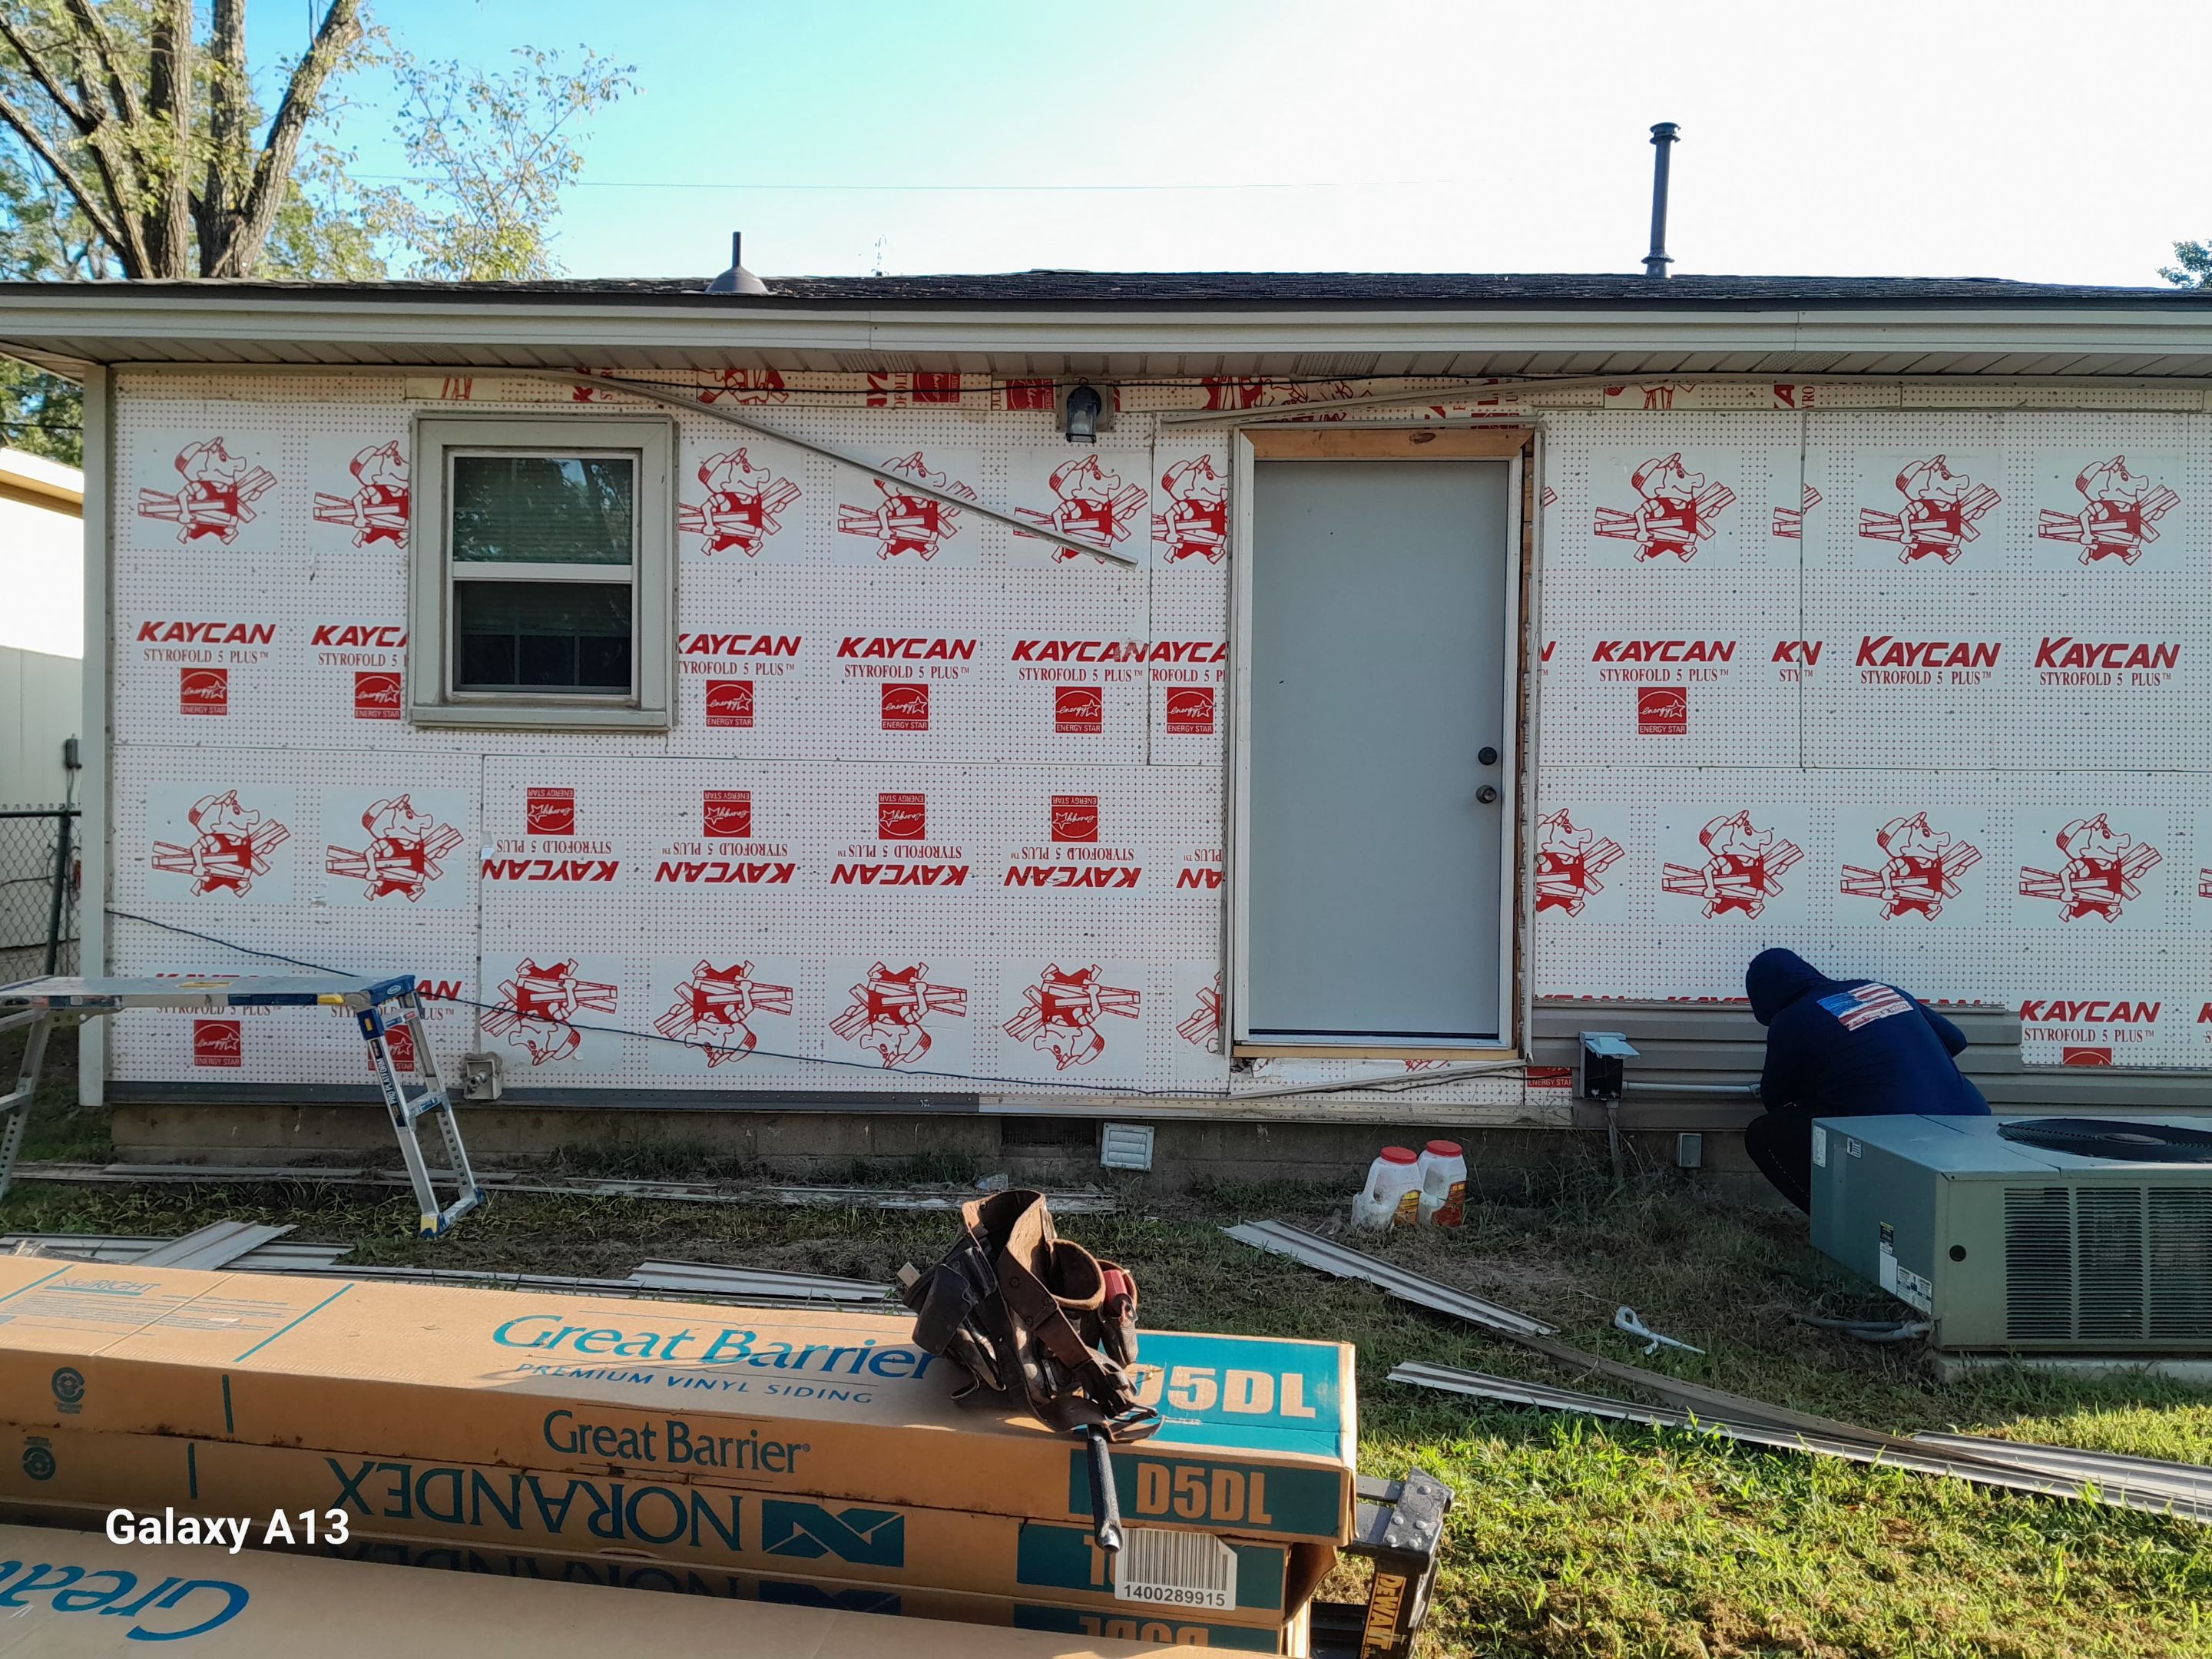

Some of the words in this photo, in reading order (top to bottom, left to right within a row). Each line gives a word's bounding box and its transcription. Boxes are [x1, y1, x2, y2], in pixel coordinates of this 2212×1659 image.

[137, 621, 276, 644] KAYCAN
[144, 648, 212, 662] STYROFOLD
[218, 651, 224, 663] 5
[838, 637, 977, 661] KAYCAN
[1012, 641, 1149, 662] KAYCAN
[1592, 641, 1736, 662] KAYCAN
[1856, 636, 2002, 668] KAYCAN
[2035, 637, 2180, 669] KAYCAN
[318, 652, 386, 666] STYROFOLD
[392, 654, 397, 667] 5
[743, 662, 749, 674] 5
[843, 664, 912, 678] STYROFOLD
[919, 666, 924, 678] 5
[1019, 667, 1086, 681] STYROFOLD
[1093, 669, 1098, 681] 5
[1600, 668, 1670, 681] STYROFOLD
[1677, 669, 1682, 681] 5
[1204, 670, 1210, 682] 5
[1861, 671, 1931, 684] STYROFOLD
[1937, 671, 1942, 684] 5
[2040, 672, 2111, 686] STYROFOLD
[2117, 673, 2123, 686] 5
[497, 839, 525, 853] PLUS
[531, 840, 537, 853] 5
[543, 841, 611, 854] STYROFOLD
[707, 843, 714, 855] 5
[720, 843, 787, 856] STYROFOLD
[883, 845, 888, 857] 5
[894, 844, 962, 859] STYROFOLD
[1055, 847, 1061, 859] 5
[1067, 847, 1135, 861] STYROFOLD
[482, 859, 619, 882] KAYCAN
[655, 862, 796, 884] KAYCAN
[831, 864, 969, 886] KAYCAN
[1005, 866, 1141, 888] KAYCAN
[2019, 1000, 2161, 1023] KAYCAN
[2025, 1028, 2095, 1041] STYROFOLD
[2102, 1029, 2108, 1042] 5
[492, 1314, 694, 1360] Great
[700, 1329, 941, 1379] Barrier
[515, 1363, 654, 1384] PREMIUM
[667, 1376, 750, 1393] VINYL
[764, 1384, 873, 1404] SIDING
[1124, 1363, 1316, 1419] D5DL
[544, 1409, 657, 1462] Great
[1137, 1462, 1272, 1524] D5DL
[324, 1458, 743, 1551] NORANDEX
[1124, 1584, 1226, 1607] 1400289915
